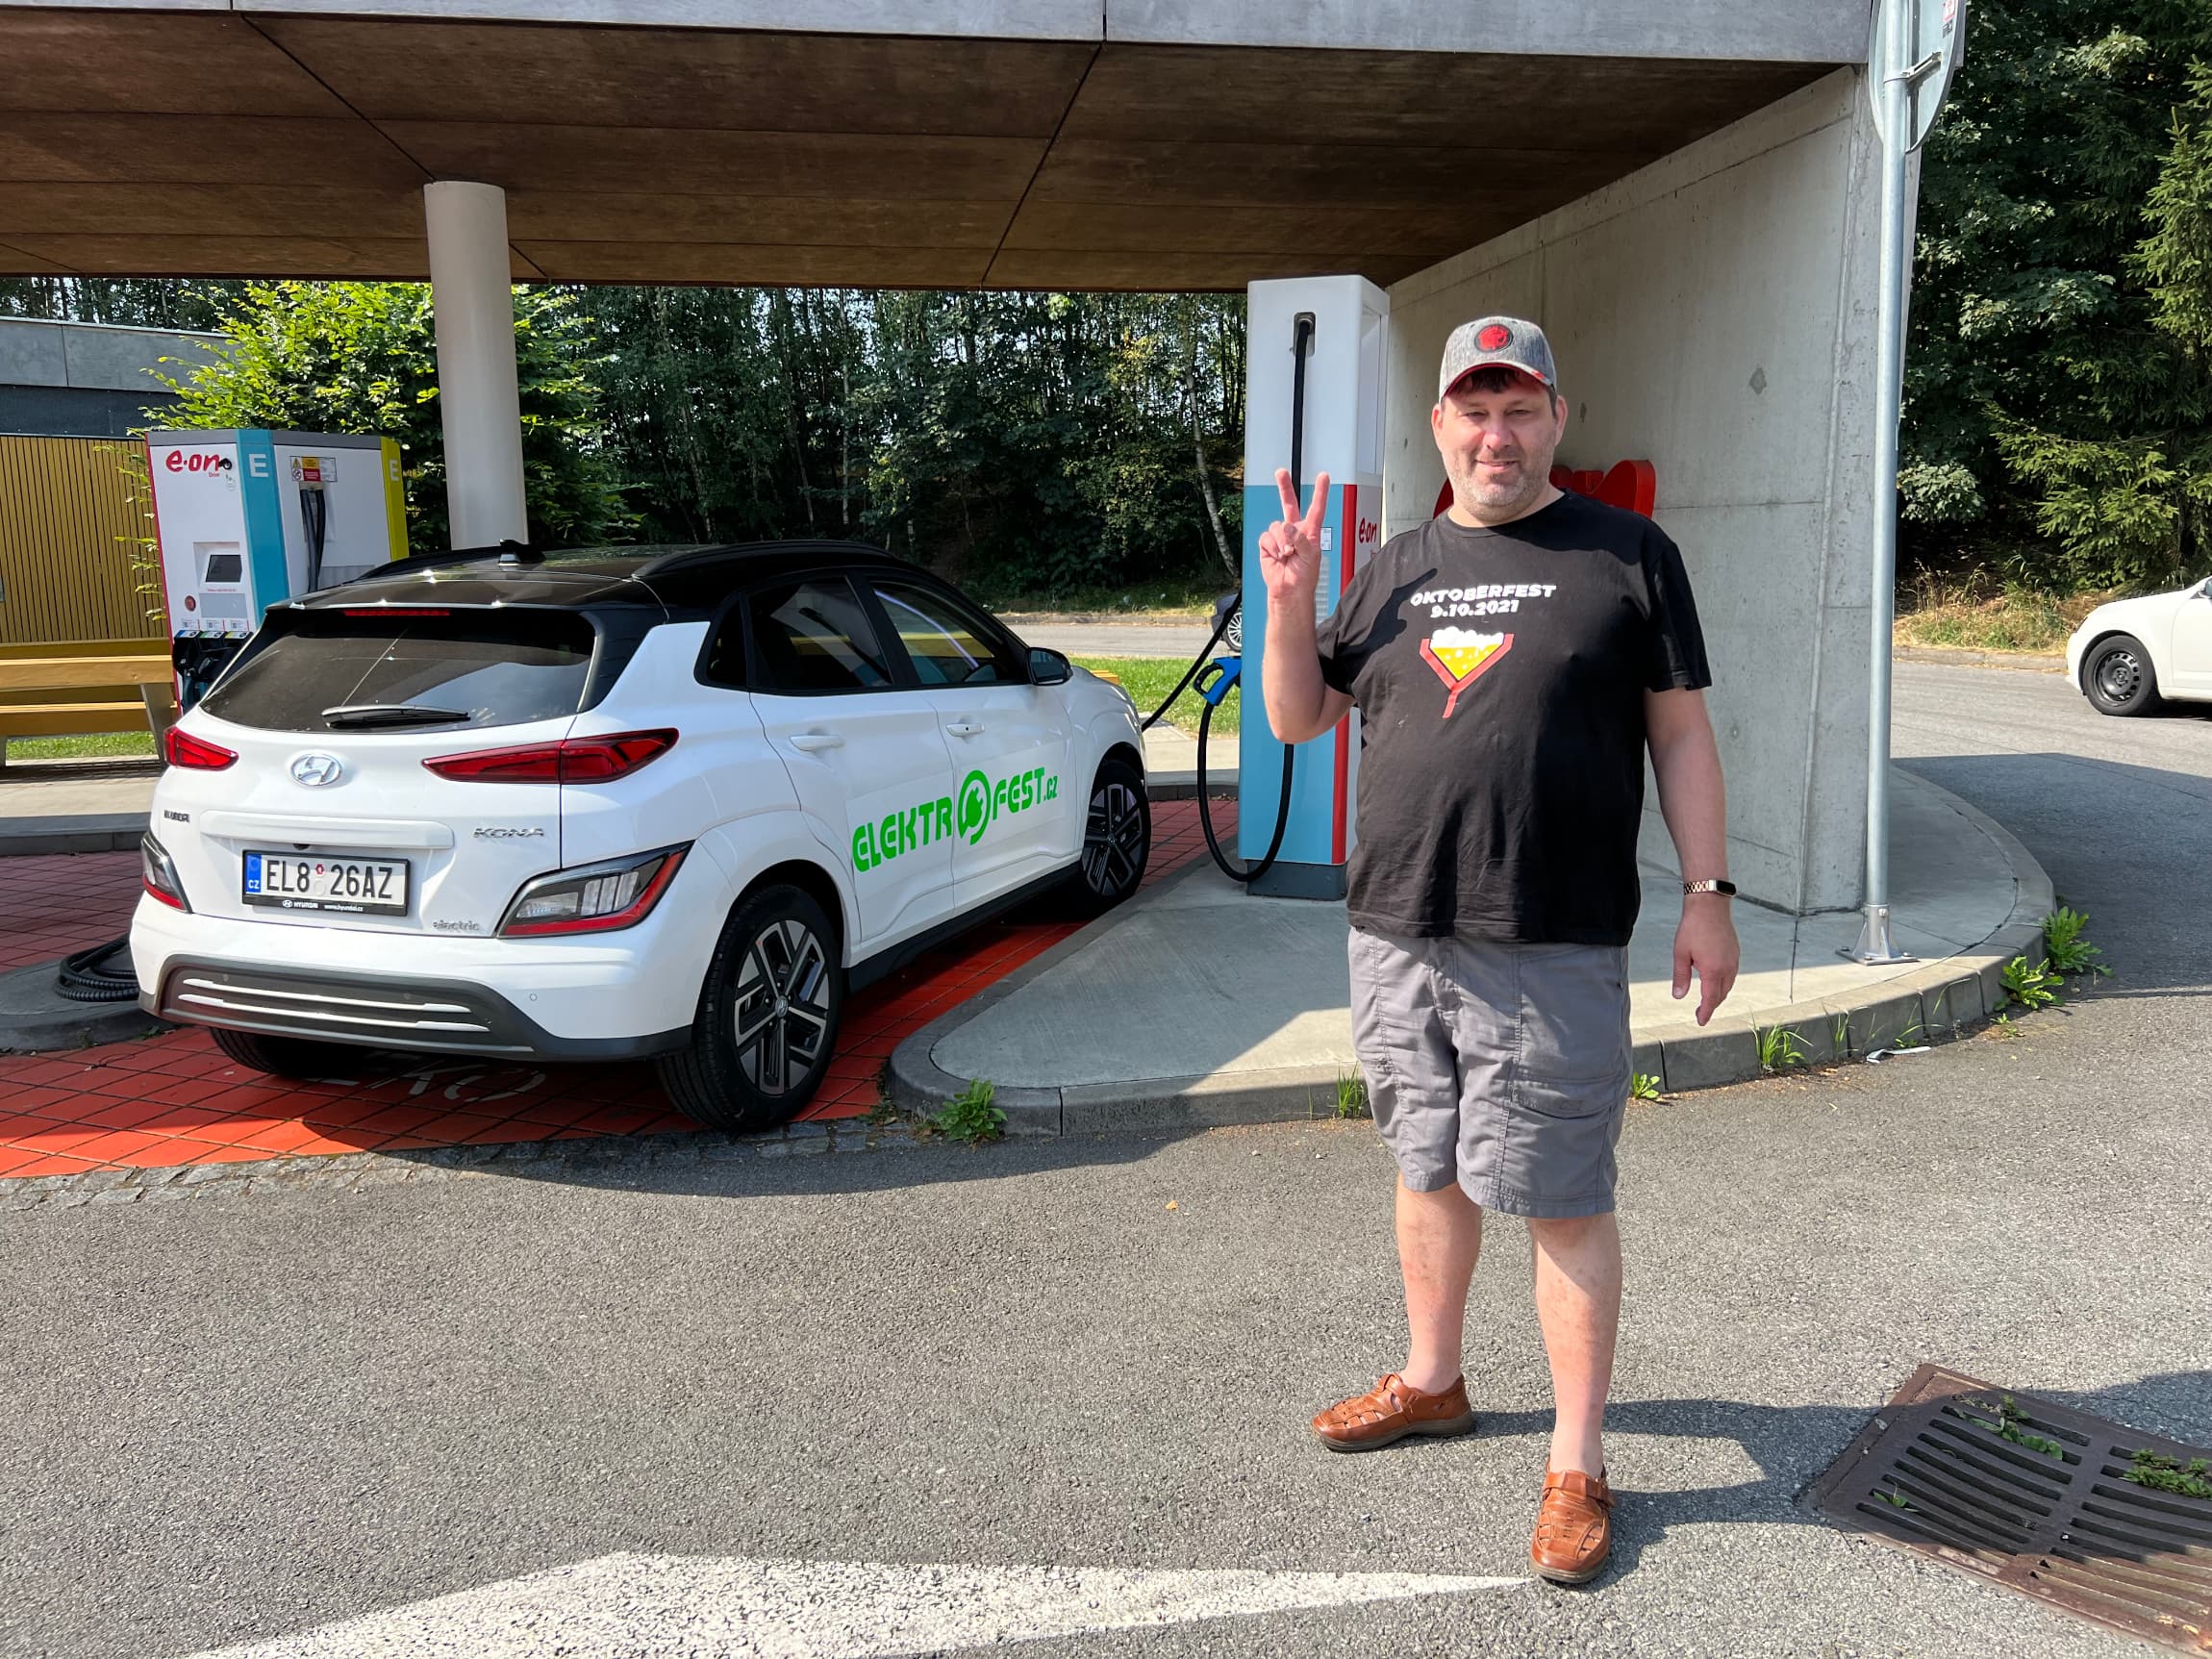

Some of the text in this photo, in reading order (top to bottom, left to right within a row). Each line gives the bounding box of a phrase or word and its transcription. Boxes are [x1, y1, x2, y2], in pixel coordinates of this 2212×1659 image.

[249, 454, 268, 477] E
[390, 460, 400, 481] E
[1410, 584, 1557, 607] OKTOBERFEST
[1430, 599, 1520, 618] 9.10.2021
[472, 827, 544, 839] KONA
[247, 879, 260, 890] CZ
[266, 859, 393, 899] EL8 26AZ
[432, 918, 480, 931] electric
